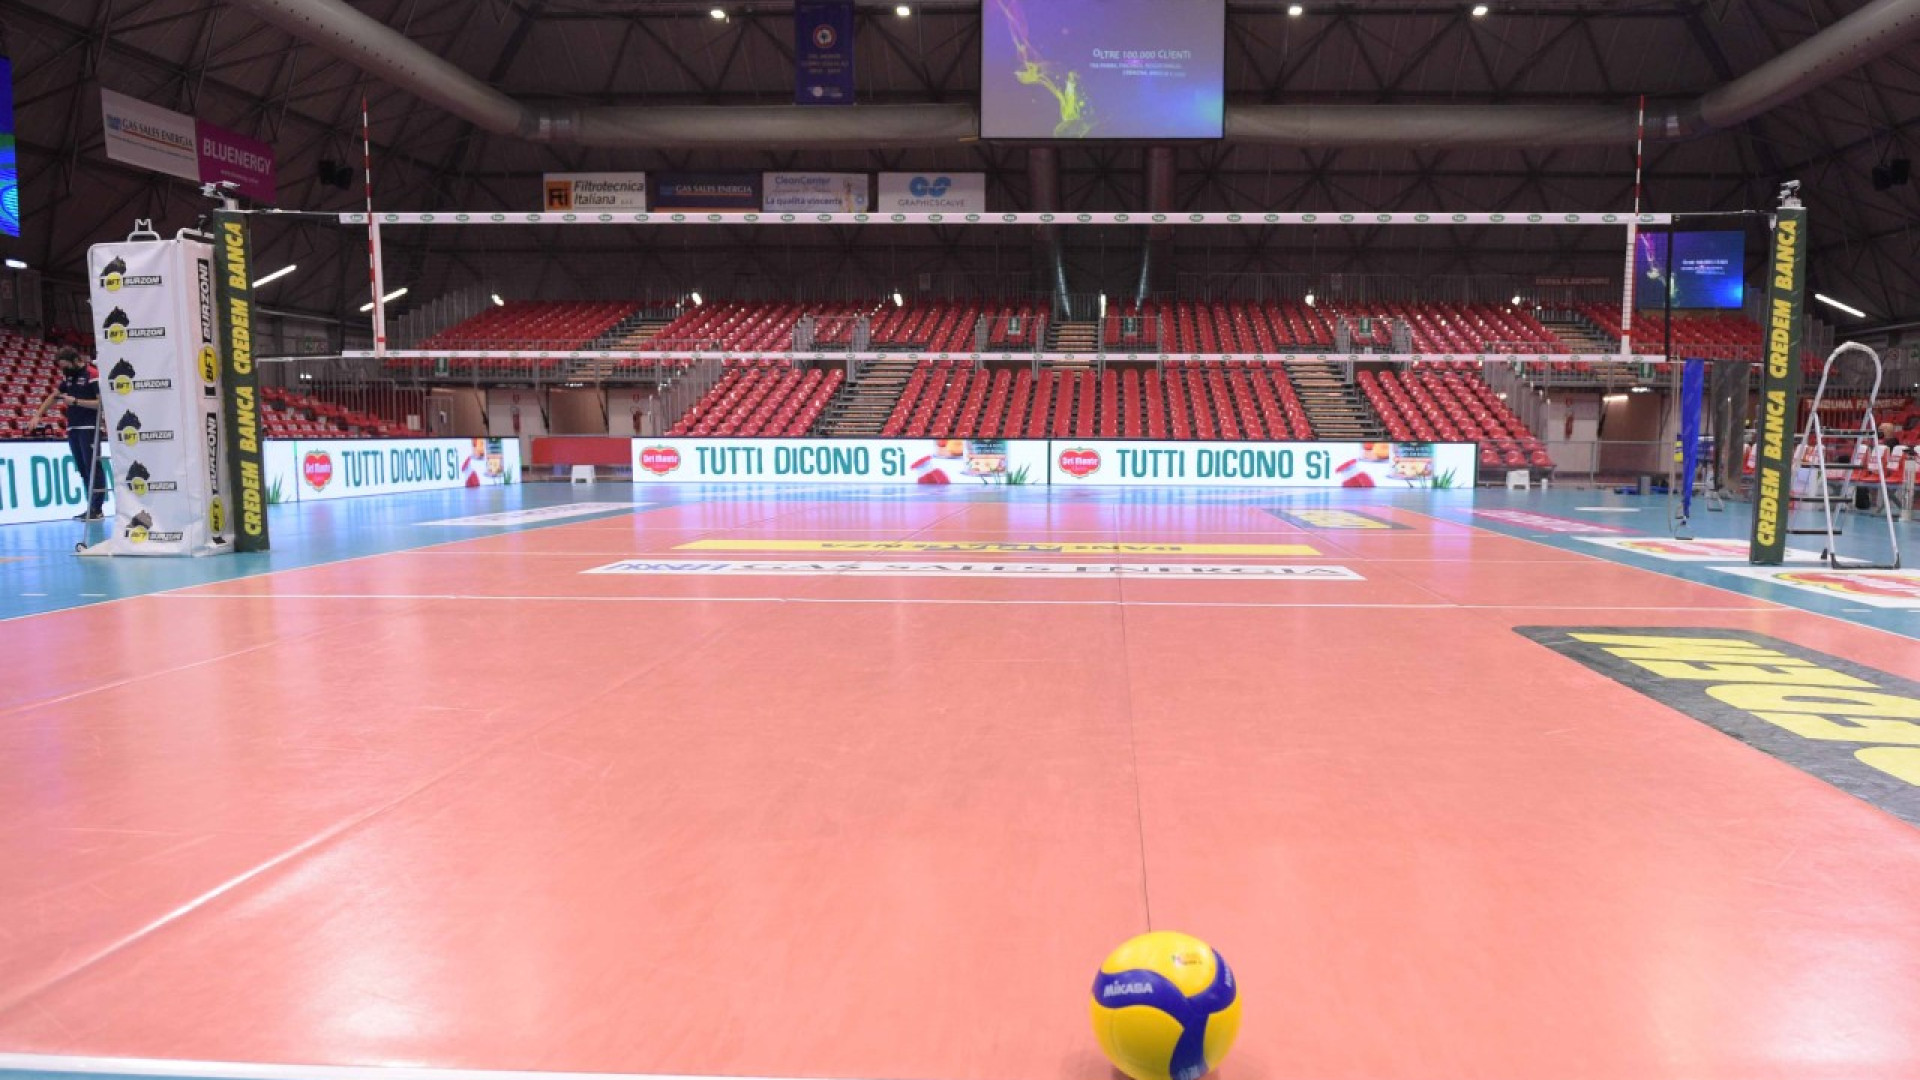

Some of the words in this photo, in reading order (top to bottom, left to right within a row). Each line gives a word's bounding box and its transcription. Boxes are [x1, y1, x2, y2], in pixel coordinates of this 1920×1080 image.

[122, 118, 138, 130] GAS
[139, 124, 159, 138] SALES
[203, 138, 272, 175] BLUENERGY
[574, 180, 644, 192] Filtrotecnica
[574, 192, 616, 205] Italiana
[676, 185, 691, 193] GAS
[718, 185, 752, 193] ENERGIA
[224, 222, 247, 290] BANCA
[1774, 219, 1797, 291] BANCA
[124, 276, 160, 286] BURZONI
[199, 263, 211, 339] BURZONI
[231, 298, 252, 375] CREDEM
[1769, 298, 1792, 379] CREDEM
[134, 380, 170, 389] BURZONI
[205, 351, 214, 380] BFT
[236, 387, 258, 454] BANCA
[1764, 390, 1786, 460] BANCA
[342, 449, 384, 487] TUTTI
[391, 447, 442, 484] DICONO
[695, 446, 763, 475] TUTTI
[775, 446, 870, 475] DICONO
[1116, 449, 1185, 478] TUTTI
[1197, 449, 1294, 479] DICONO
[240, 460, 262, 536] CREDEM
[1757, 468, 1780, 547] CREDEM
